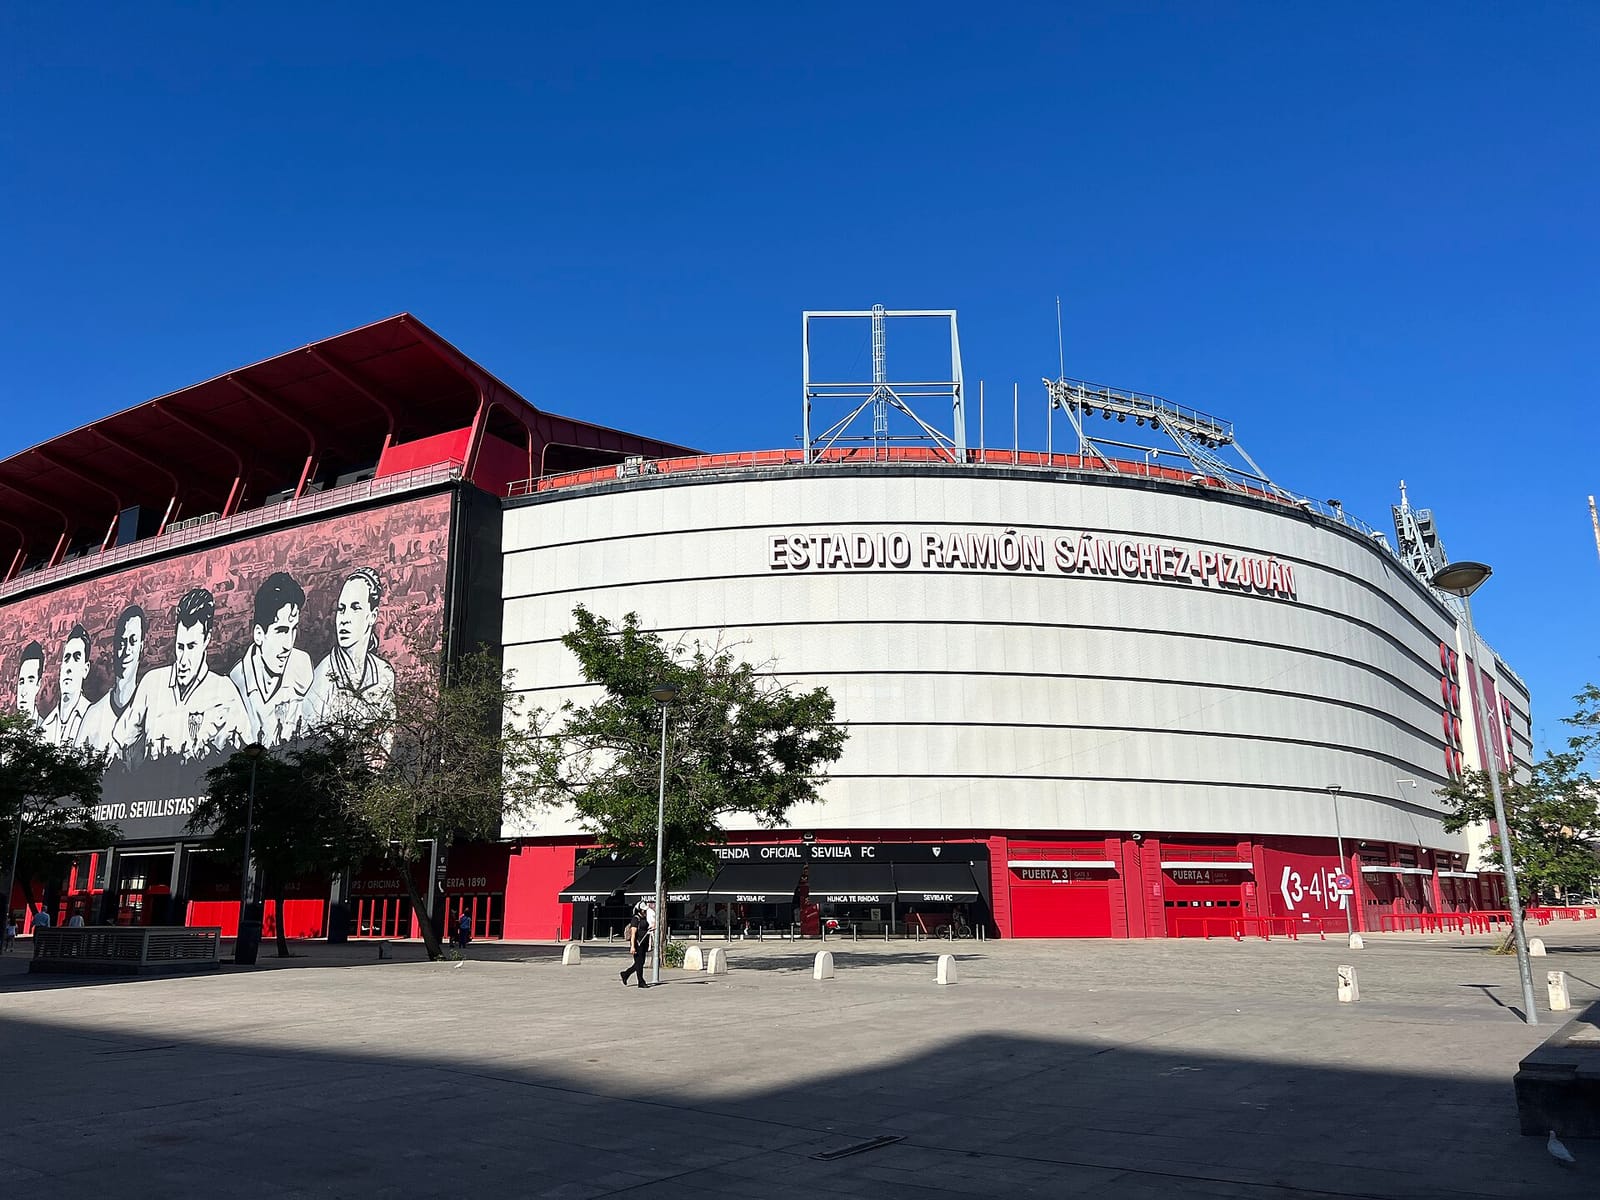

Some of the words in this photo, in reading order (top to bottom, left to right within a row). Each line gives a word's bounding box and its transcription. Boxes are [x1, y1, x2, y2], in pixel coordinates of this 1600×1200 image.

[768, 533, 911, 572] ESTADIO
[920, 527, 1045, 575] RAMÓN
[1055, 530, 1298, 601] SÁNCHEZ-PIZJUÁN
[130, 797, 195, 818] SEVILLISTAS
[712, 848, 750, 859] TIENDA
[760, 847, 801, 858] OFICIAL
[811, 846, 851, 858] SEVILLA
[861, 846, 875, 858] FC
[1022, 869, 1059, 880] PUERTA
[1062, 869, 1068, 879] 3
[1172, 870, 1202, 880] PUERTA
[1204, 870, 1210, 880] 4
[368, 880, 400, 889] OFICINAS
[446, 878, 465, 888] ERTA
[467, 877, 486, 887] 1890
